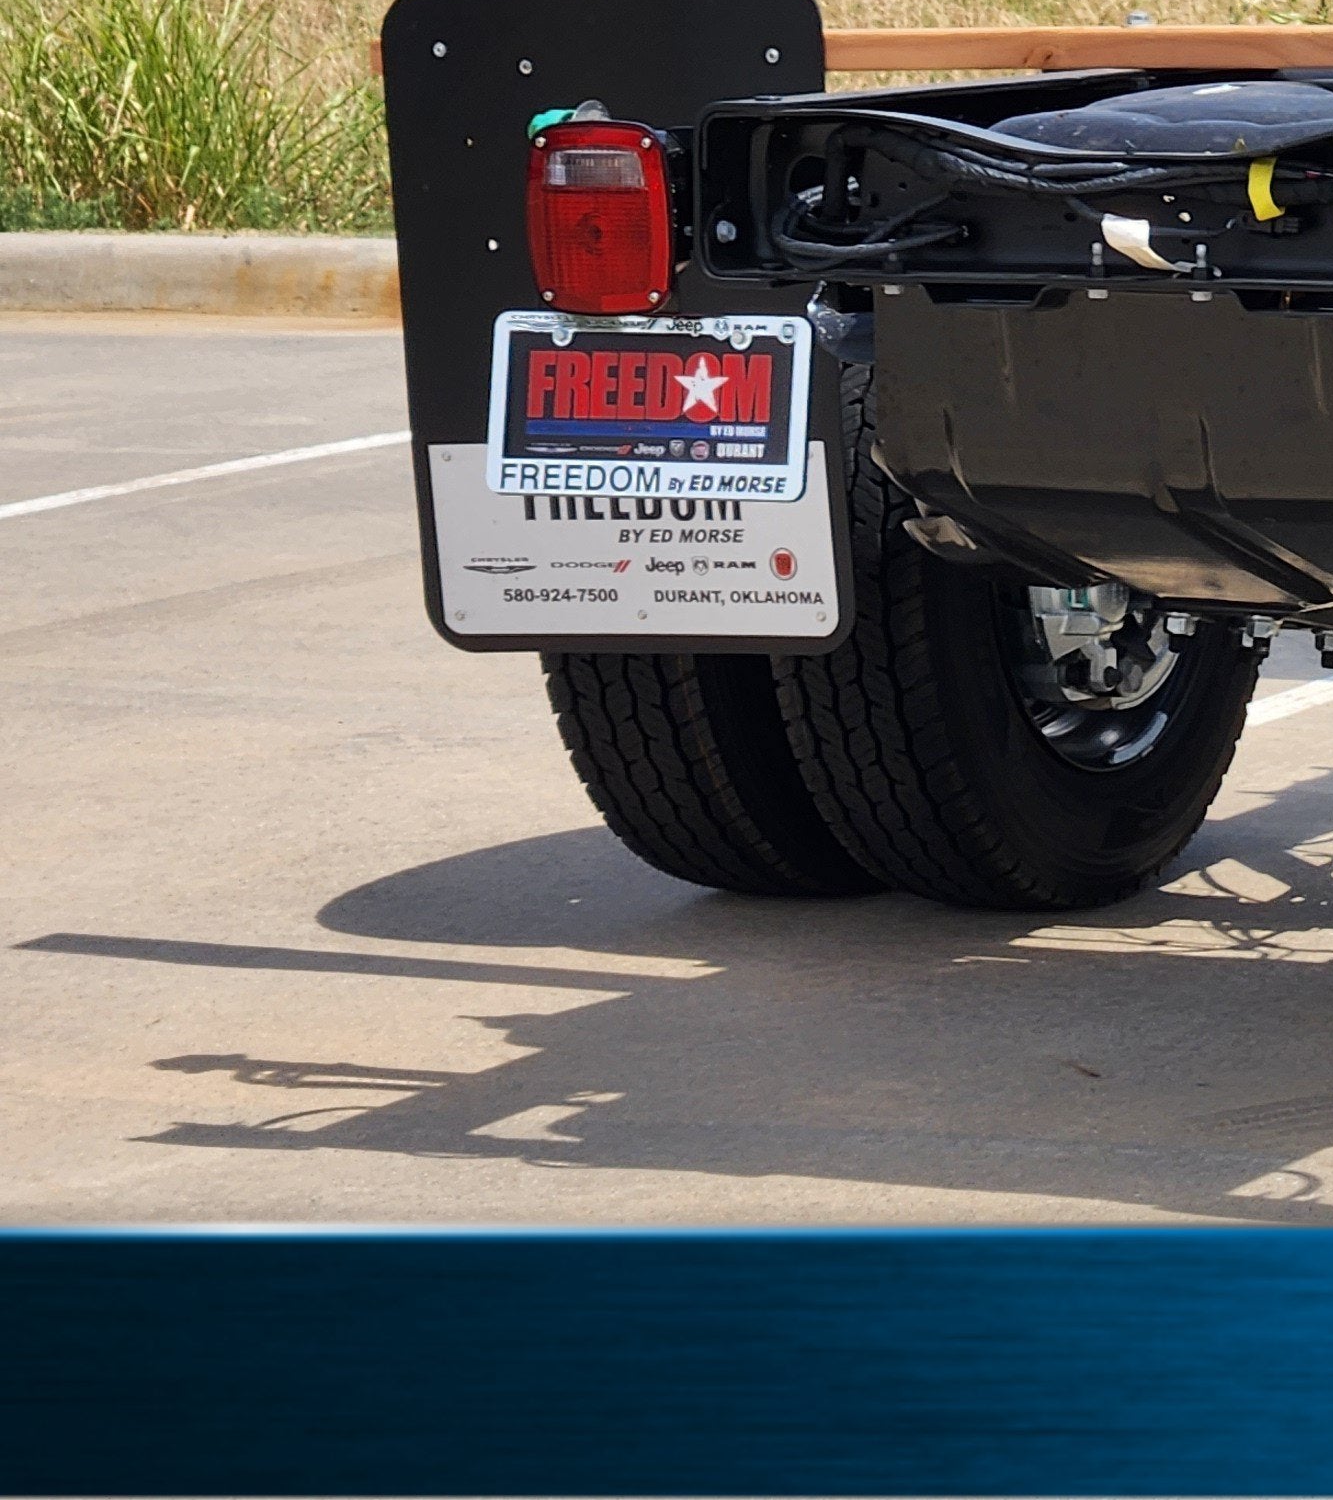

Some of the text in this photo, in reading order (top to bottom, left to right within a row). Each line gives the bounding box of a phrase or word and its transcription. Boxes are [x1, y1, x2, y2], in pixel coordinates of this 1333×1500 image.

[666, 316, 704, 333] Jeep
[634, 442, 666, 457] Jeep
[716, 442, 766, 458] DURANT
[500, 463, 662, 493] FREEDOM
[689, 475, 714, 491] ED
[717, 476, 788, 495] MORSE
[618, 528, 745, 544] BY ED MORSE
[645, 556, 685, 576] Jeep
[713, 561, 757, 569] RAM
[503, 588, 825, 607] 580-924-7500 DURANT, OKLAHOMA
